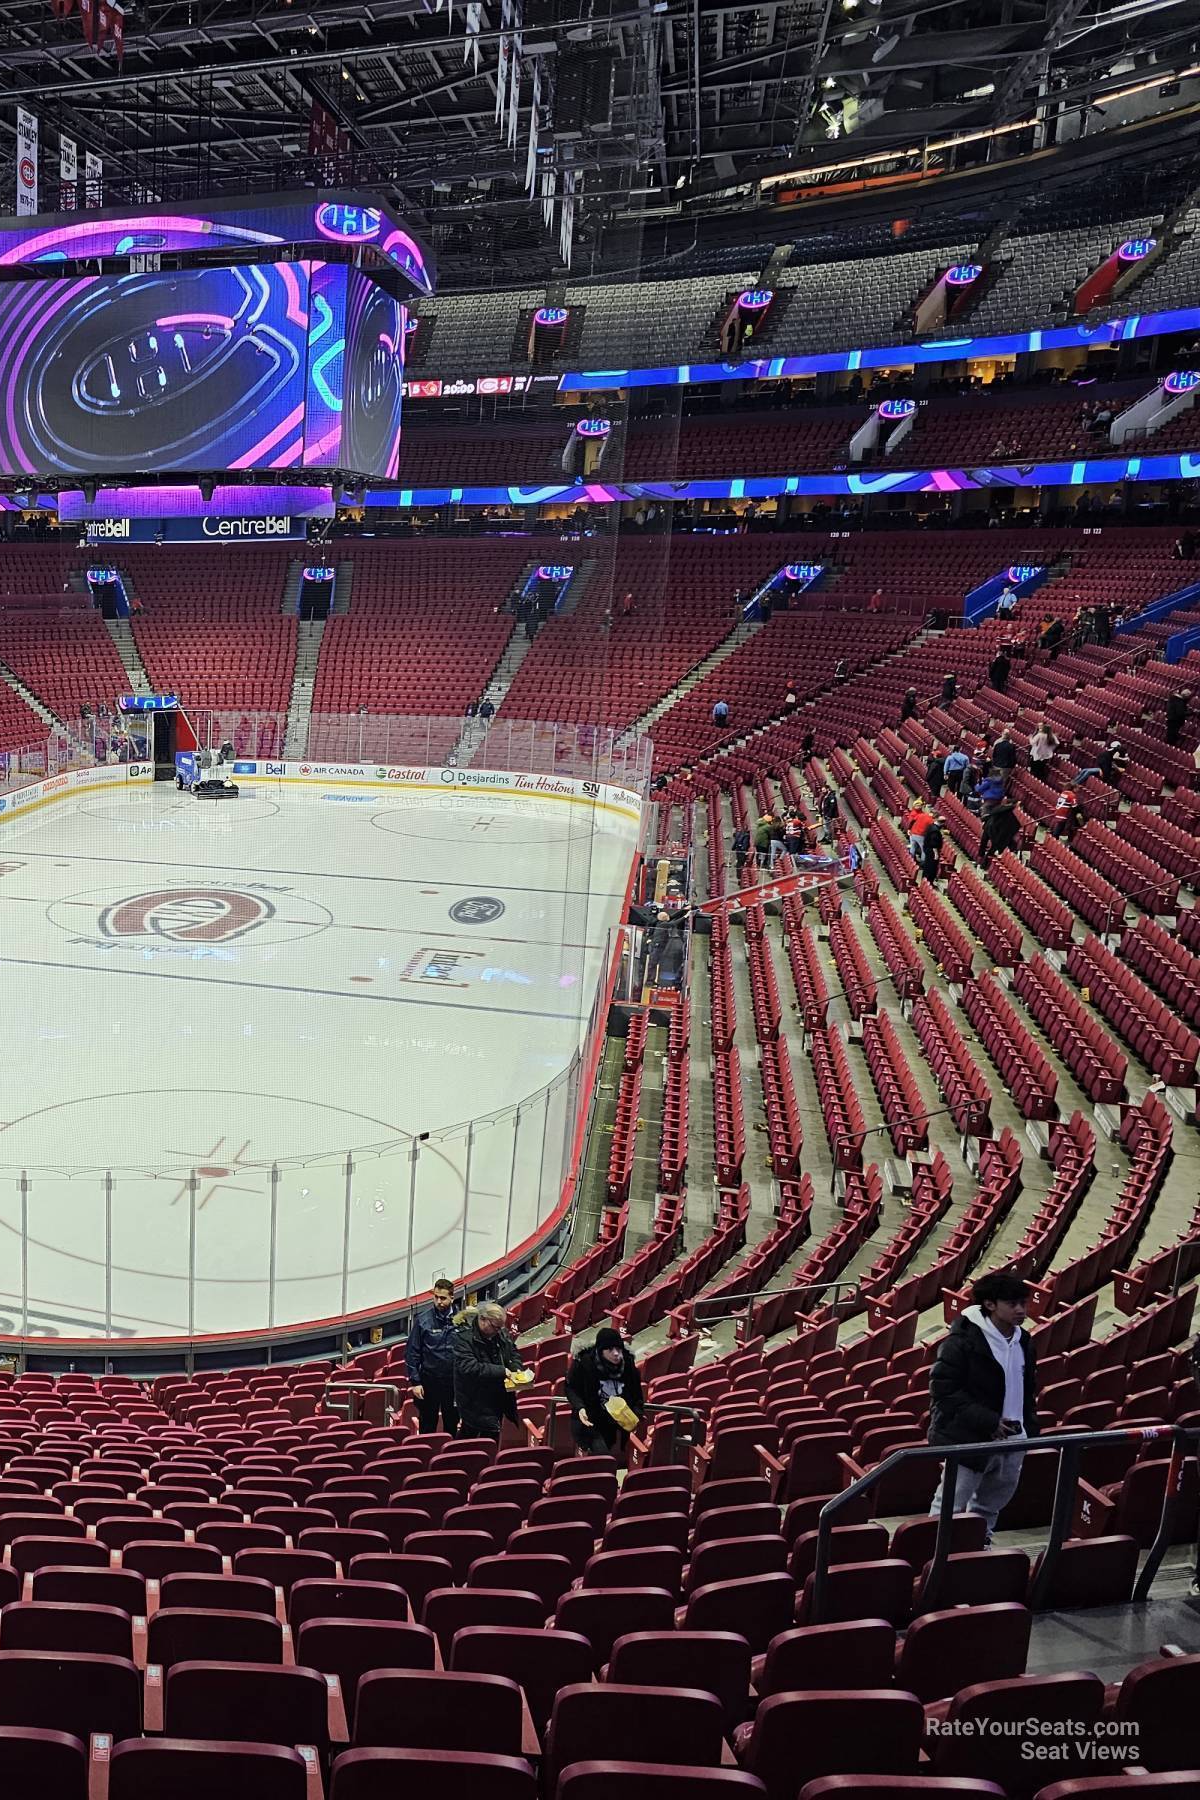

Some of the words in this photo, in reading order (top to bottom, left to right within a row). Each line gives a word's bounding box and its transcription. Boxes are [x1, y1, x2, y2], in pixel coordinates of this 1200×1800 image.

[412, 385, 421, 394] 5
[443, 384, 476, 395] 20:00
[202, 516, 291, 536] CentreBell
[265, 763, 287, 776] Bell
[313, 767, 327, 775] AIR
[328, 767, 365, 776] CANADA
[387, 768, 426, 781] Castrol
[457, 772, 510, 786] Desjardins
[514, 774, 535, 788] Tim
[535, 775, 575, 795] Hortons
[582, 782, 601, 794] SN
[1142, 1428, 1158, 1440] 106
[1082, 1500, 1091, 1512] K
